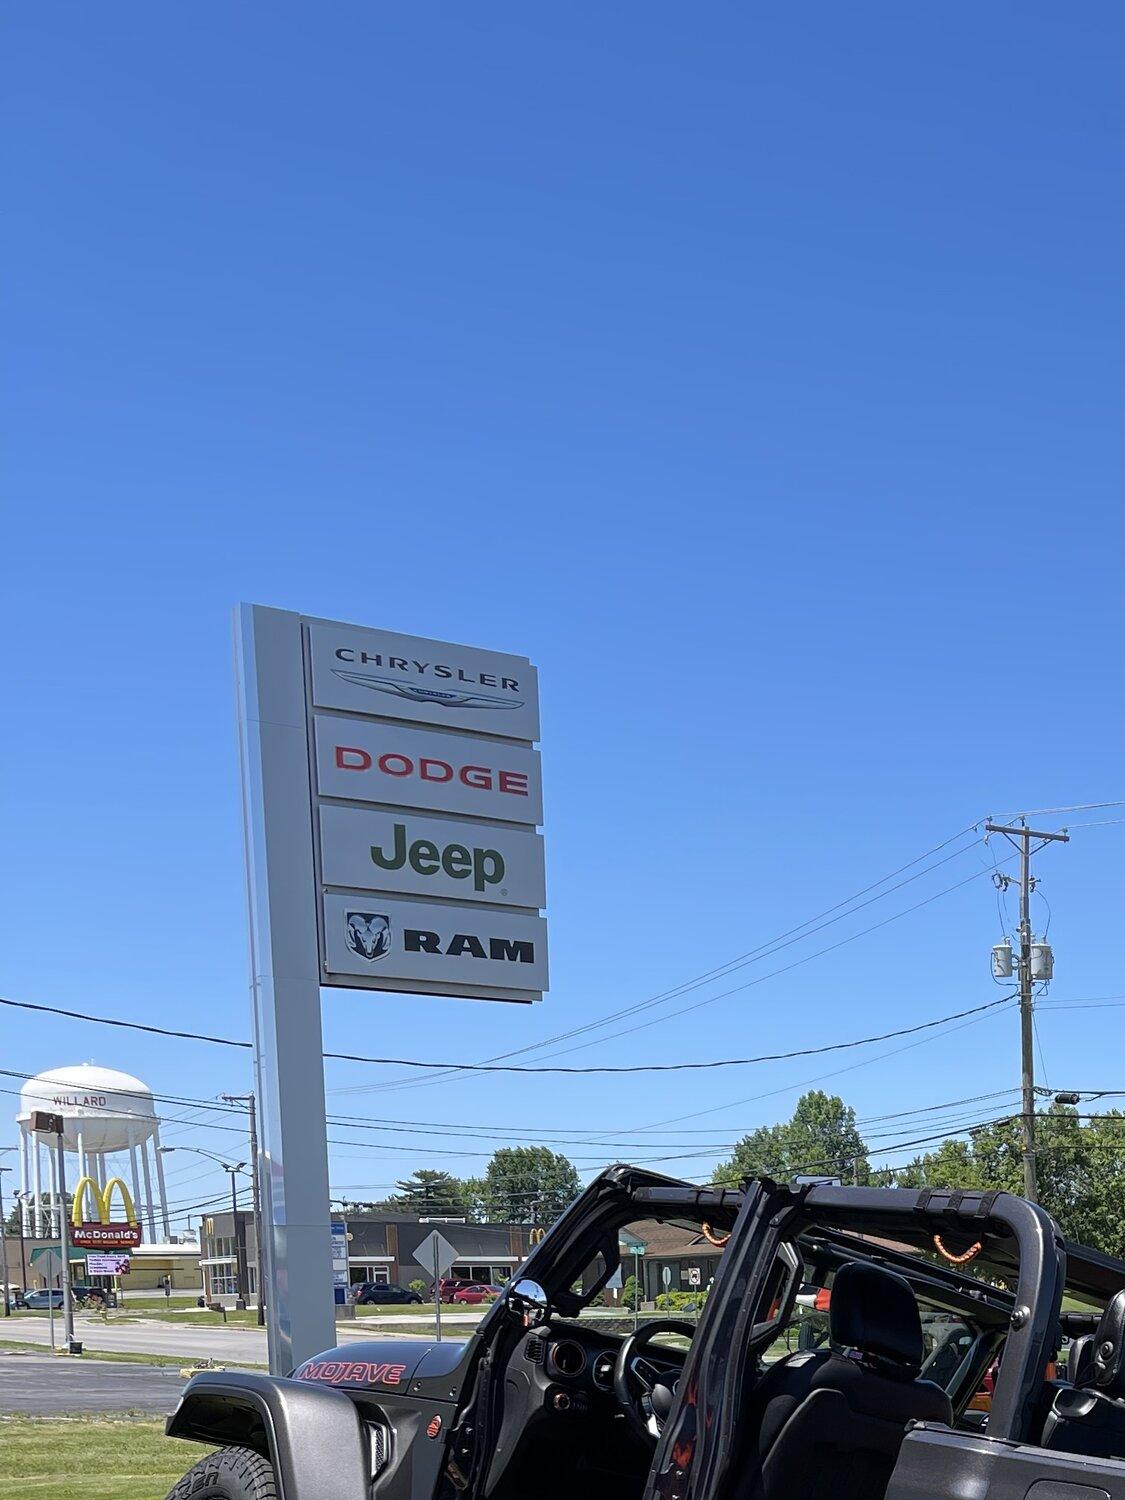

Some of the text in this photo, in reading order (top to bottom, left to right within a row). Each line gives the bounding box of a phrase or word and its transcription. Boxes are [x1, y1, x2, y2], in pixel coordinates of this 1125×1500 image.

[335, 648, 520, 693] CHRYSLER
[335, 746, 529, 797] DODGE
[370, 824, 506, 891] Jeep
[404, 929, 535, 964] RAM
[53, 1096, 107, 1106] WILLARD
[74, 1230, 139, 1239] McDonald's
[299, 1362, 407, 1385] MOJAVE
